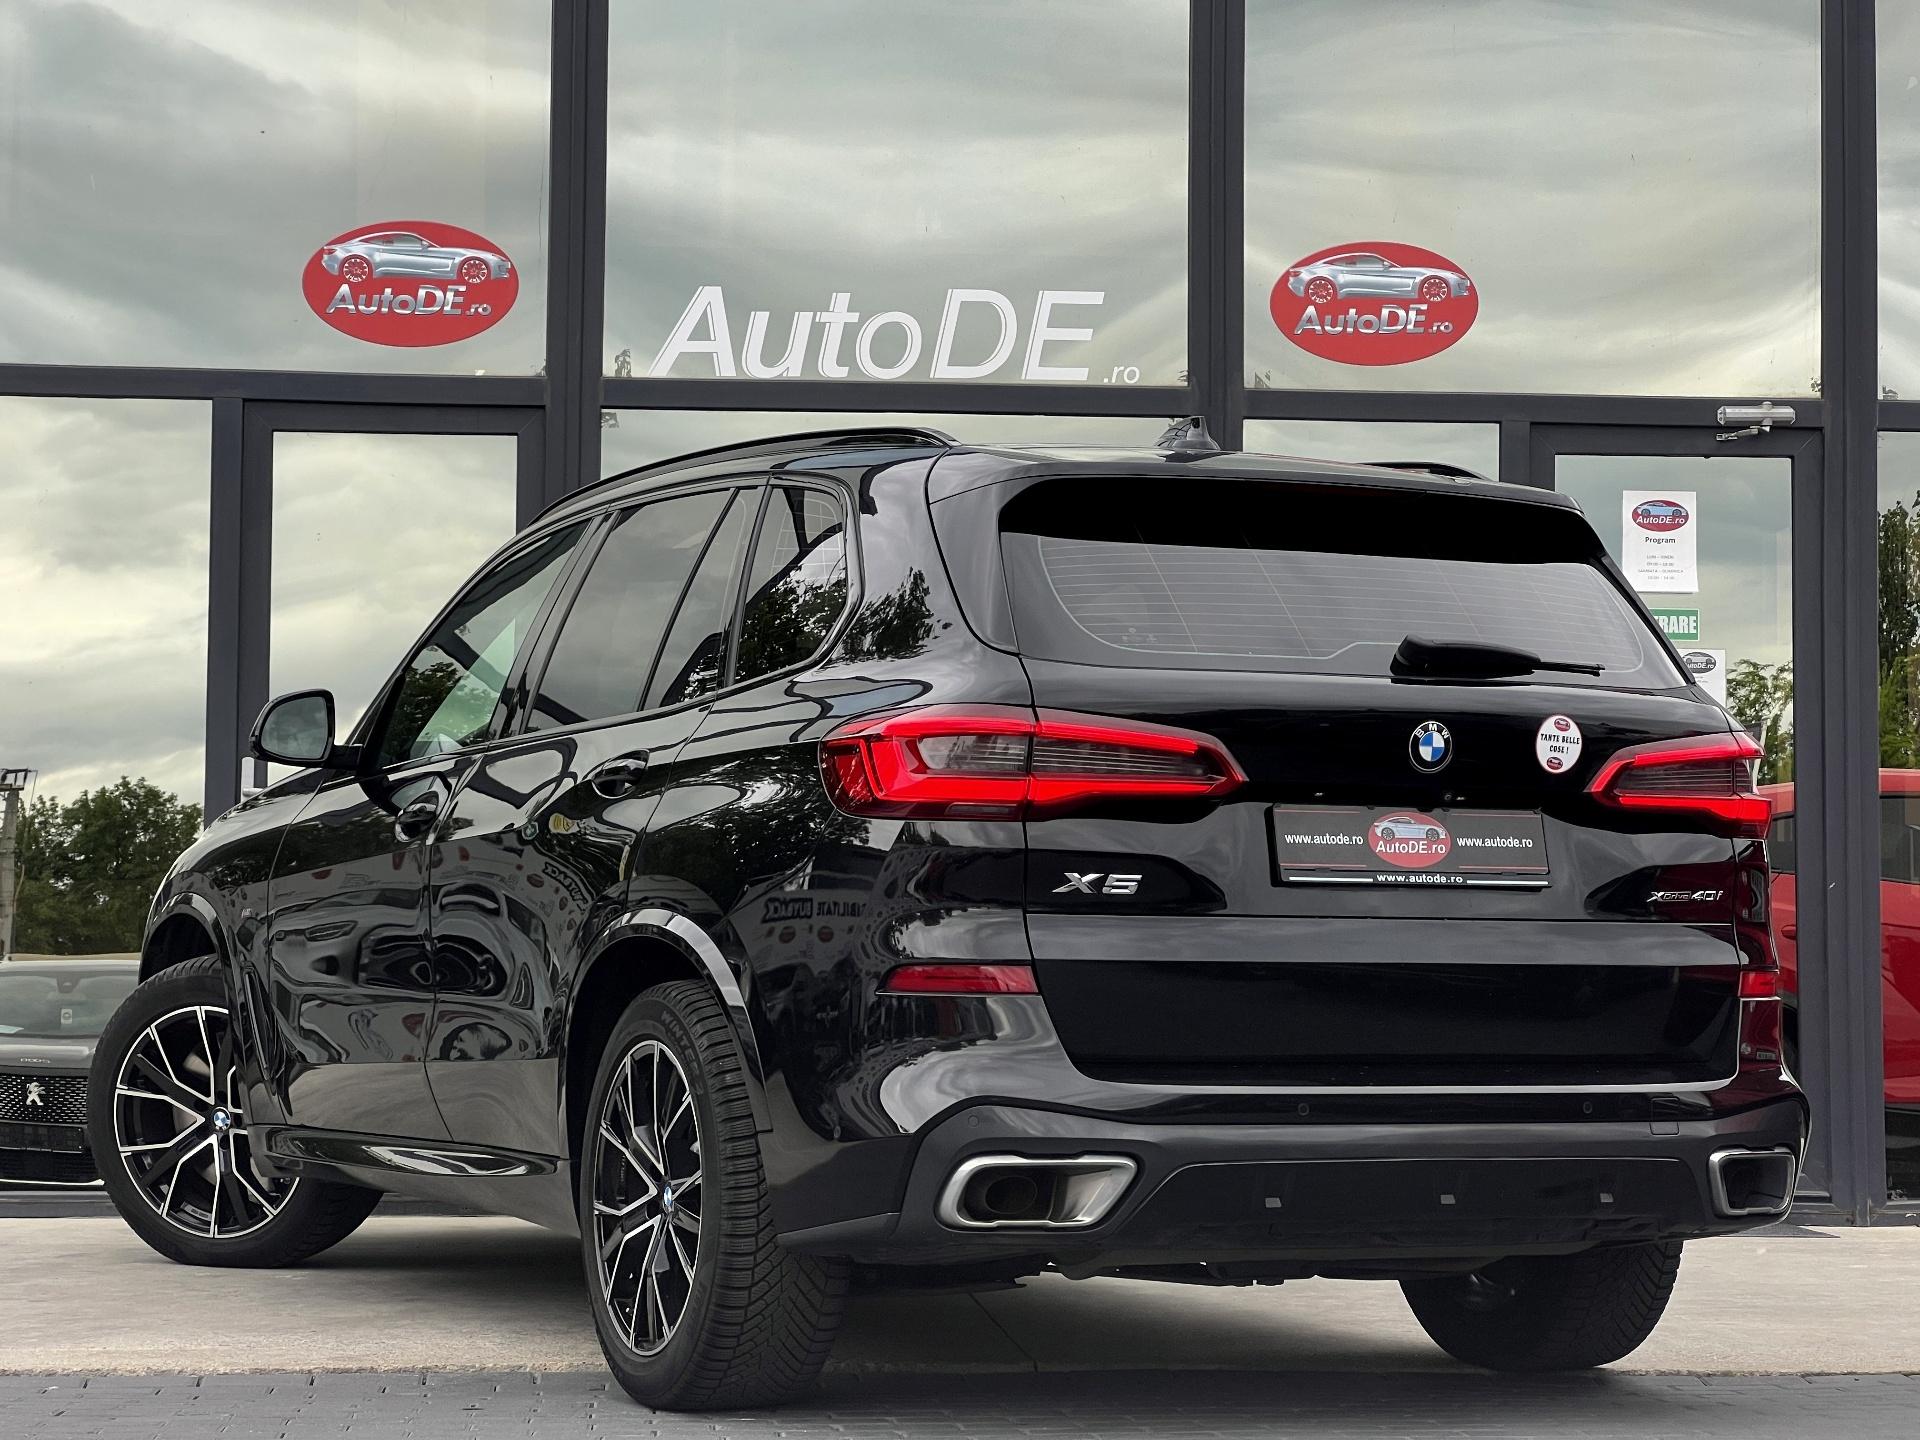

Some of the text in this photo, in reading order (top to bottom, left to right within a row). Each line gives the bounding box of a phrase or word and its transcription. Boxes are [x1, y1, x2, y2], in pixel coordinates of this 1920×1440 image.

[1636, 515, 1686, 525] AutoDE.ro
[1645, 536, 1676, 545] Program
[1655, 615, 1697, 634] RARE
[1414, 722, 1450, 739] BMW
[1540, 733, 1580, 745] TANTE BELLE
[1549, 744, 1565, 754] COSE
[1284, 832, 1364, 845] www.autode.ro
[1456, 835, 1533, 848] www.autode.ro
[1375, 840, 1446, 854] AutoDE.ro
[1051, 872, 1143, 895] X5
[1376, 873, 1463, 884] www.autode.ro
